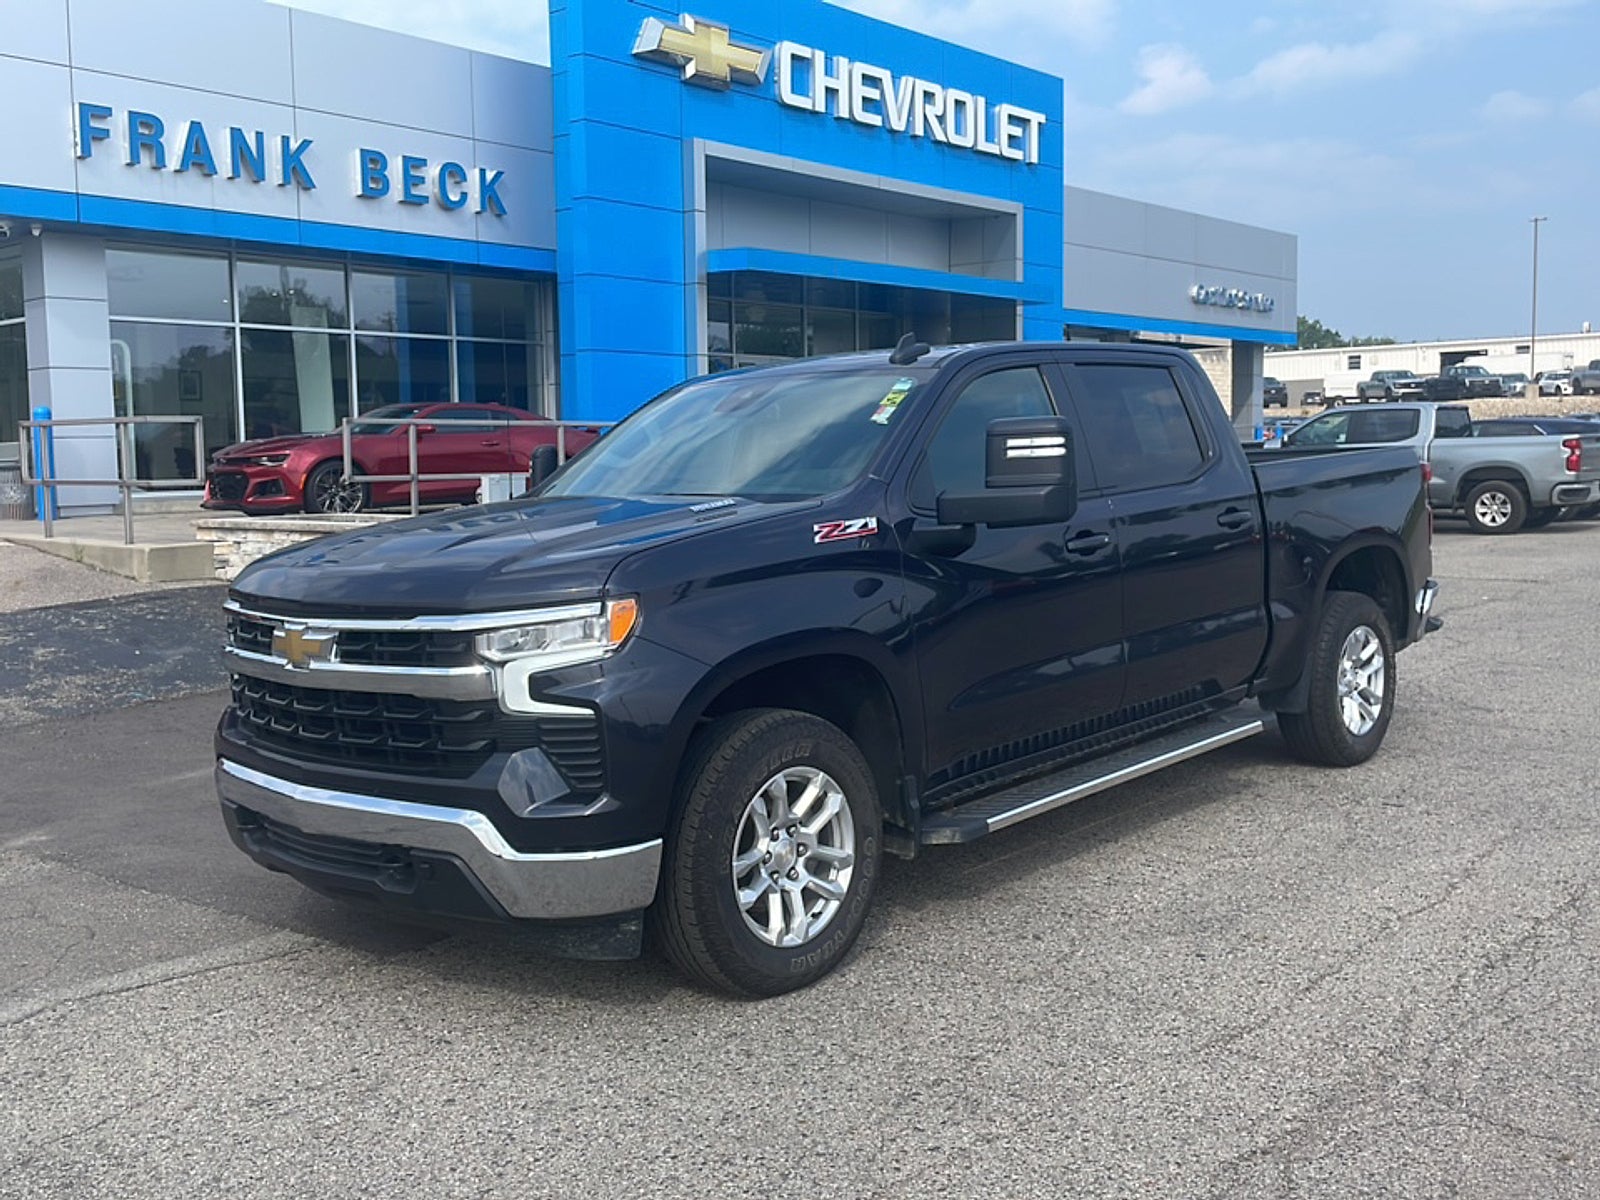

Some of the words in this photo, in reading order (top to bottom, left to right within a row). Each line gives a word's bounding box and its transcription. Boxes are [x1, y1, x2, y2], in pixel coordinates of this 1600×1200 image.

[75, 102, 316, 190] FRANK
[357, 147, 507, 216] BECK
[776, 40, 1046, 164] CHEVROLET
[813, 516, 878, 544] Z71
